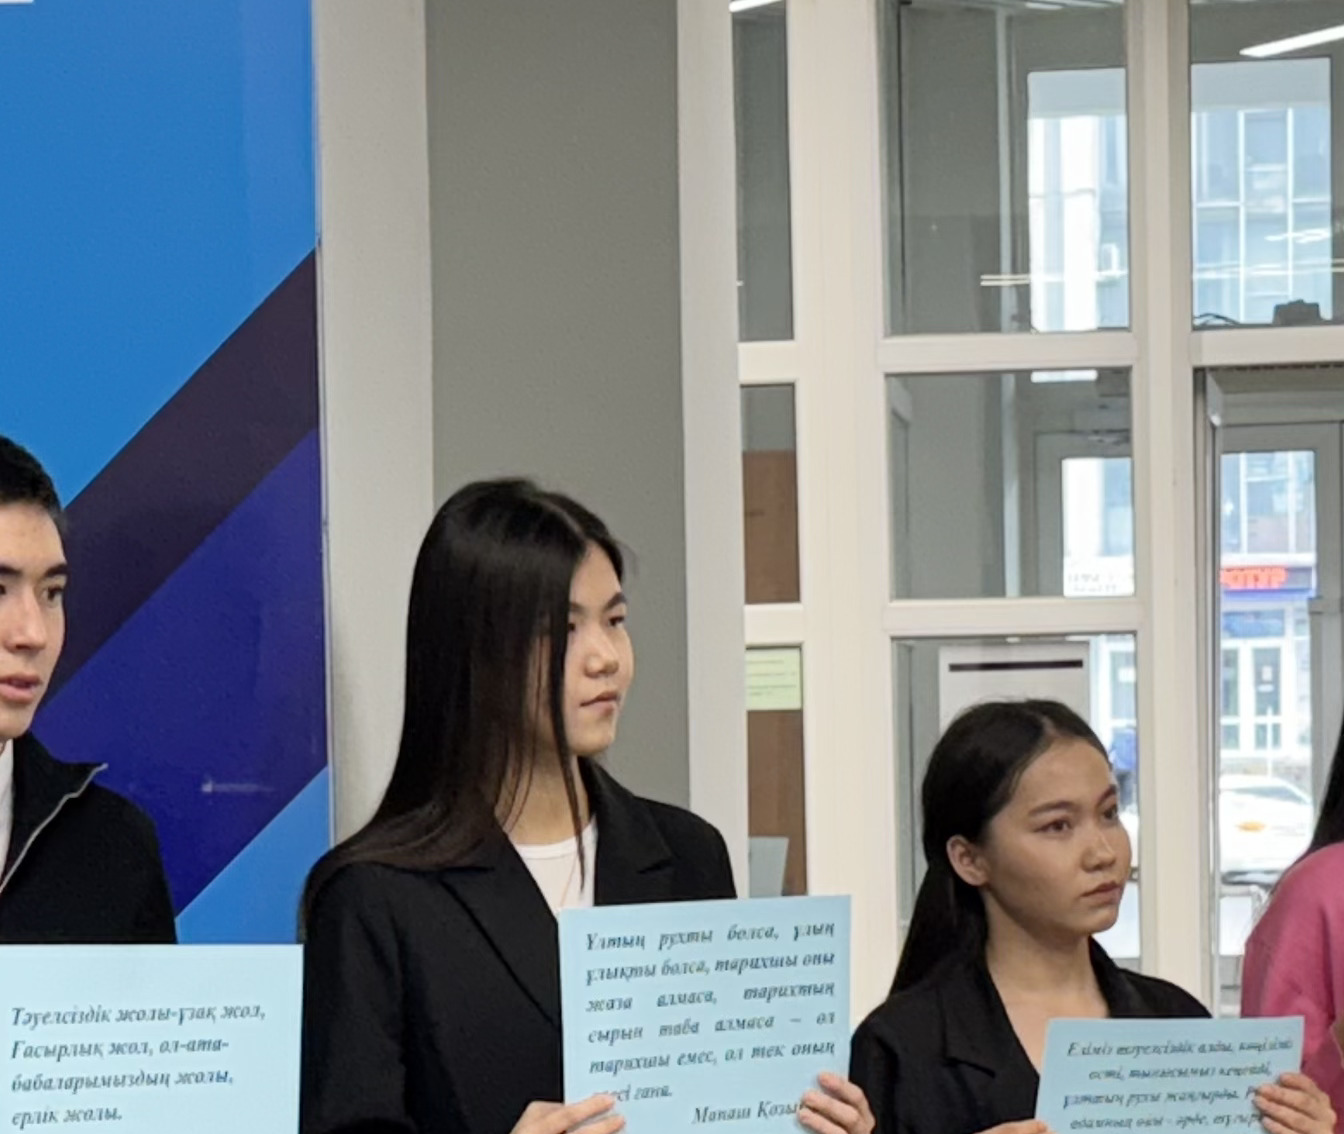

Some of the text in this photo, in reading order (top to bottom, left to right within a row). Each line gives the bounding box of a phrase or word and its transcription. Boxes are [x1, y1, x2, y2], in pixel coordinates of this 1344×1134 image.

[657, 929, 714, 952] рухты
[661, 960, 710, 976] болса,
[715, 955, 798, 975] тарихшы
[802, 953, 835, 966] оны
[12, 1005, 112, 1031] Тәуелсіздік
[220, 1005, 265, 1020] жол,
[658, 1017, 700, 1037] таба
[714, 1015, 775, 1033] алмаса
[108, 1042, 153, 1056] жол,
[589, 1054, 670, 1077] тарихшы
[751, 1045, 785, 1059] тек
[11, 1070, 170, 1095] бабаларымыздың
[12, 1108, 122, 1131] ерлік жолы.
[692, 1105, 751, 1124] Манаш
